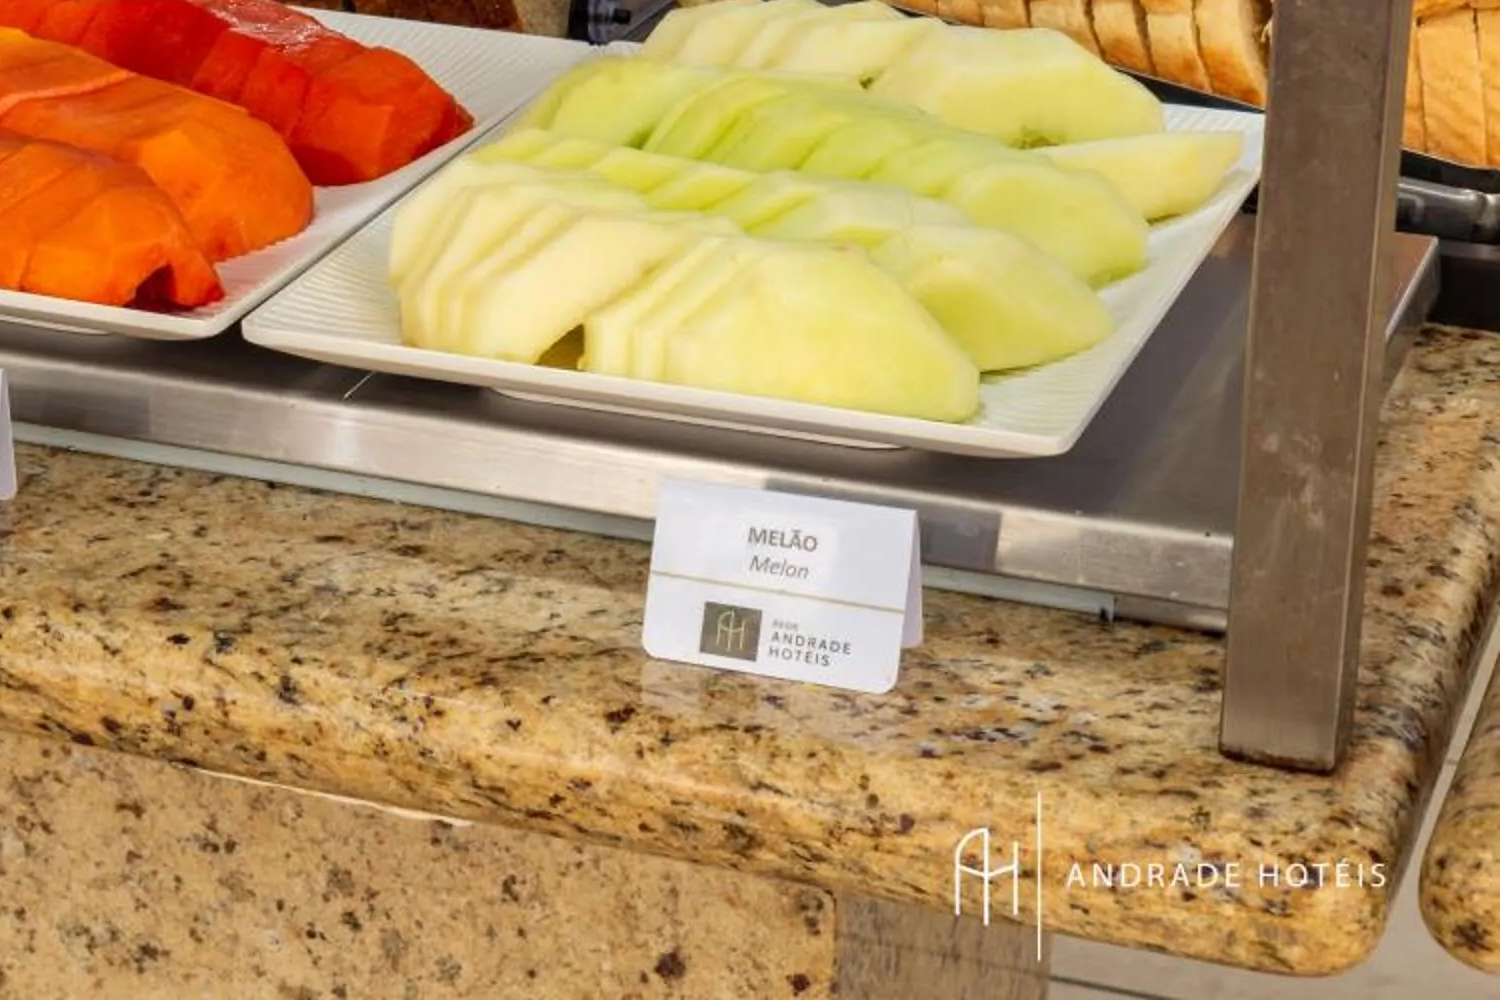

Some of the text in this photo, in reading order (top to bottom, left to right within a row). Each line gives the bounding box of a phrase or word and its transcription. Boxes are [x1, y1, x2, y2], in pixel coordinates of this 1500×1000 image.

[748, 526, 818, 552] MELÃO
[749, 555, 809, 579] Melon
[771, 631, 852, 656] ANDRADE
